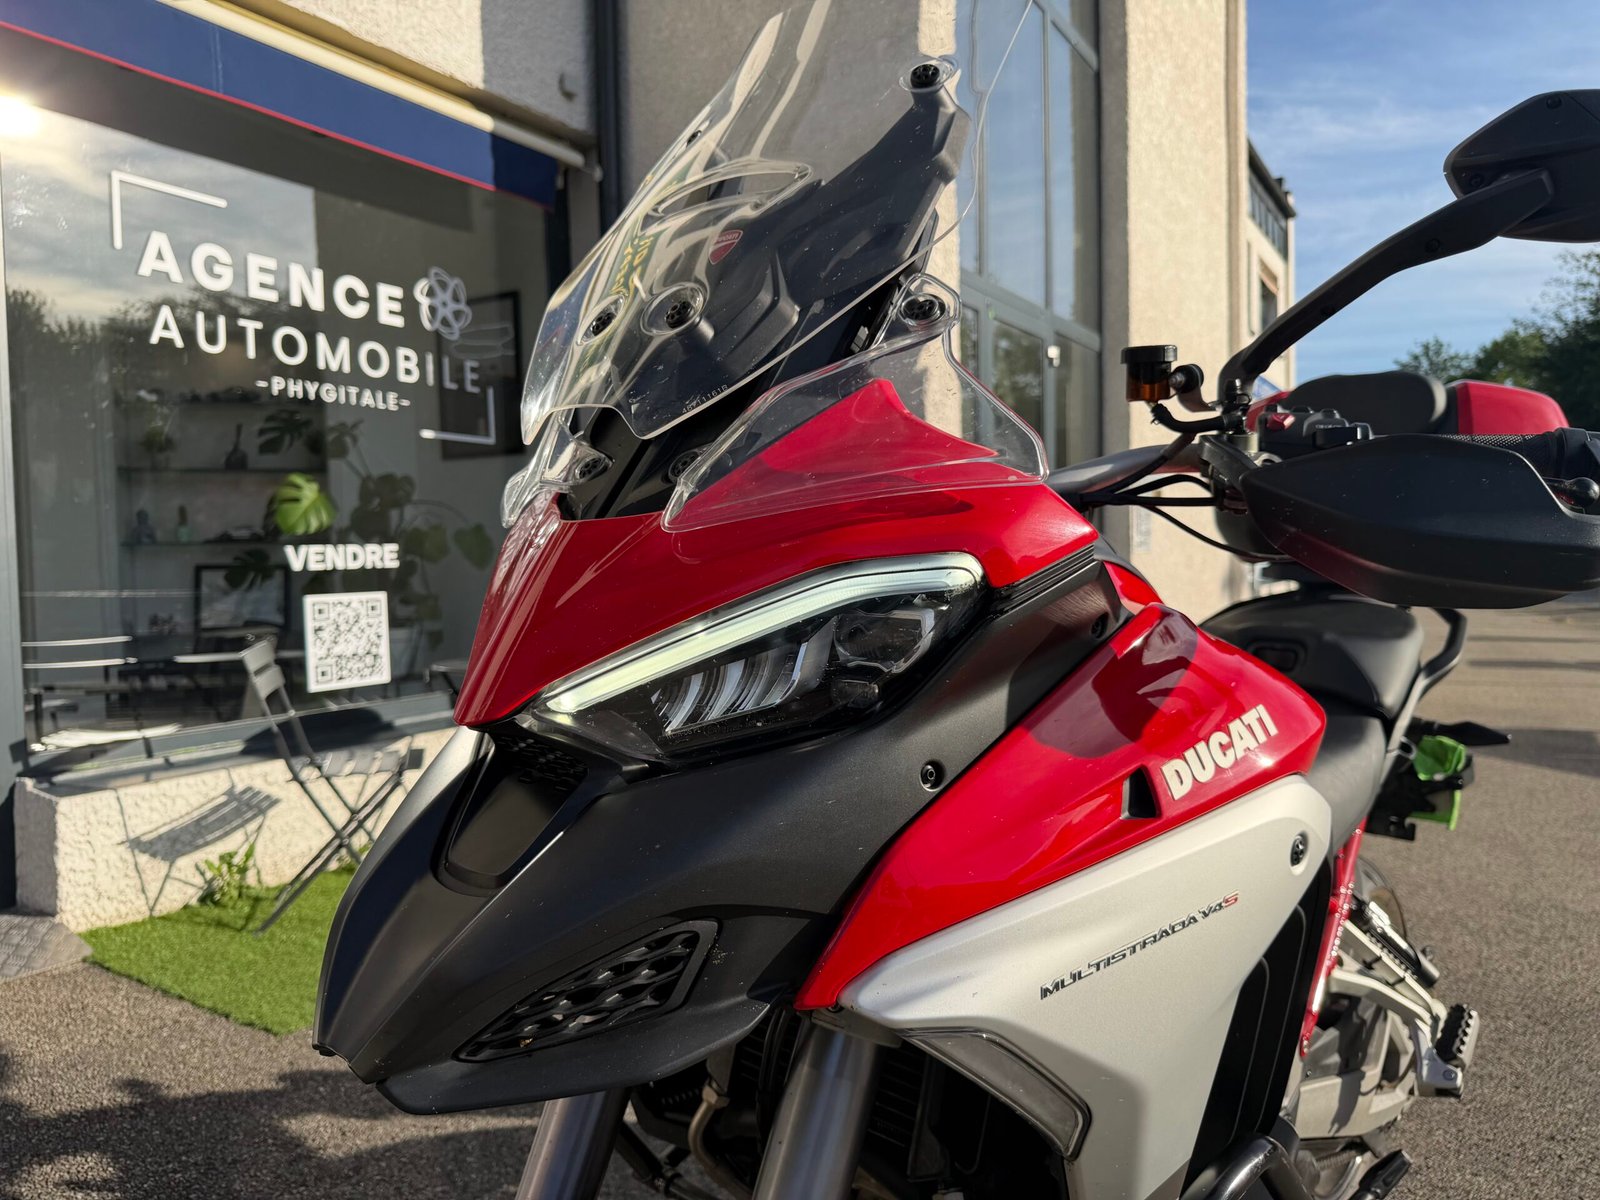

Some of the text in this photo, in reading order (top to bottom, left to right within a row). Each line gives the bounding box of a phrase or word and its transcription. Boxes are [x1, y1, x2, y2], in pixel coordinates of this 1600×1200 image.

[137, 230, 405, 329] AGENCE
[149, 304, 481, 394] AUTOMOBILE
[283, 542, 400, 572] VENDRE
[1160, 703, 1279, 801] DUCATI
[1040, 912, 1199, 1000] MULTISTRADA
